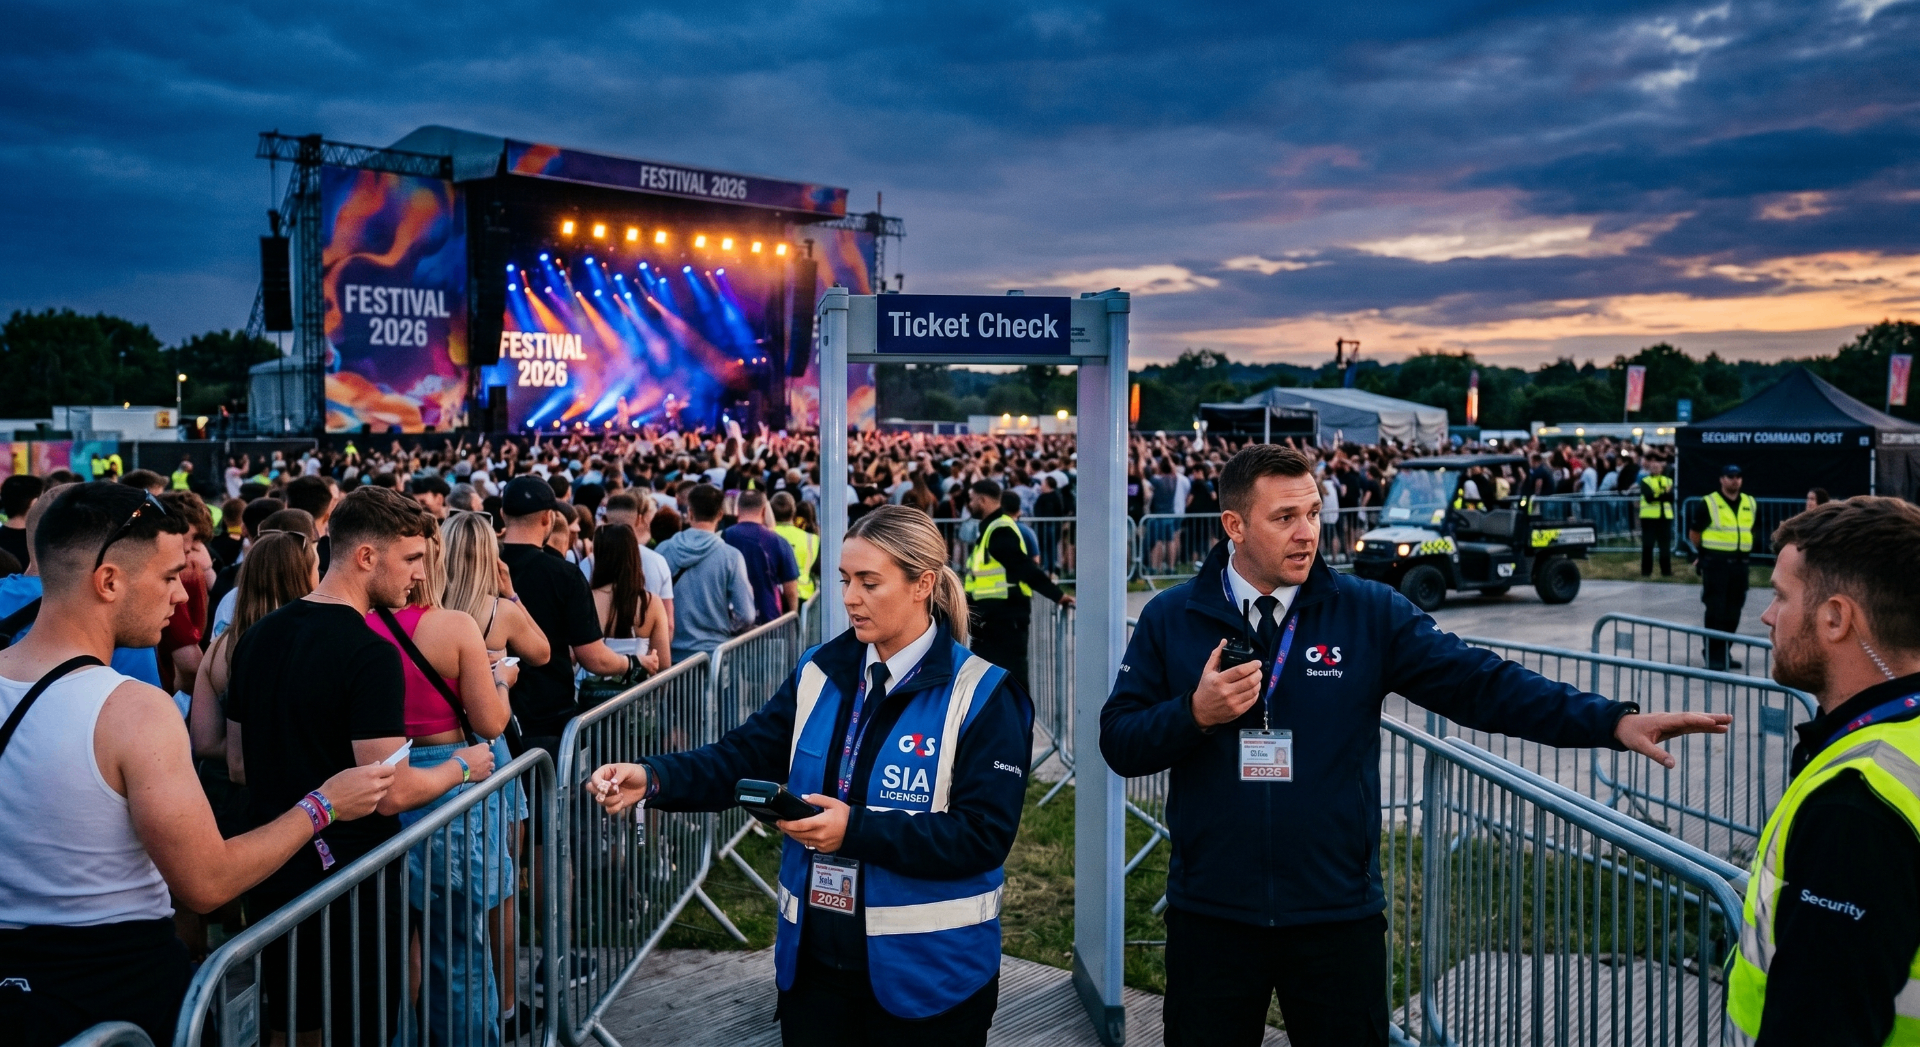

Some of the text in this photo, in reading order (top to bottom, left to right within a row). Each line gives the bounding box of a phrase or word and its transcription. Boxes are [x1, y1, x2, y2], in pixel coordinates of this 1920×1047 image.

[640, 165, 747, 200] FESTIVAL 2026
[345, 284, 450, 318] FESTIVAL
[369, 316, 428, 347] 2026
[888, 311, 1059, 339] Ticket Check
[499, 331, 587, 361] FESTIVAL
[518, 359, 568, 387] 2026
[1701, 431, 1844, 444] SECURITY COMMAND POST
[1306, 668, 1343, 678] Security
[882, 764, 930, 793] SIA
[1250, 767, 1282, 777] 2026
[880, 789, 929, 803] LICENSED
[817, 892, 847, 908] 2026
[1800, 889, 1866, 921] Security
